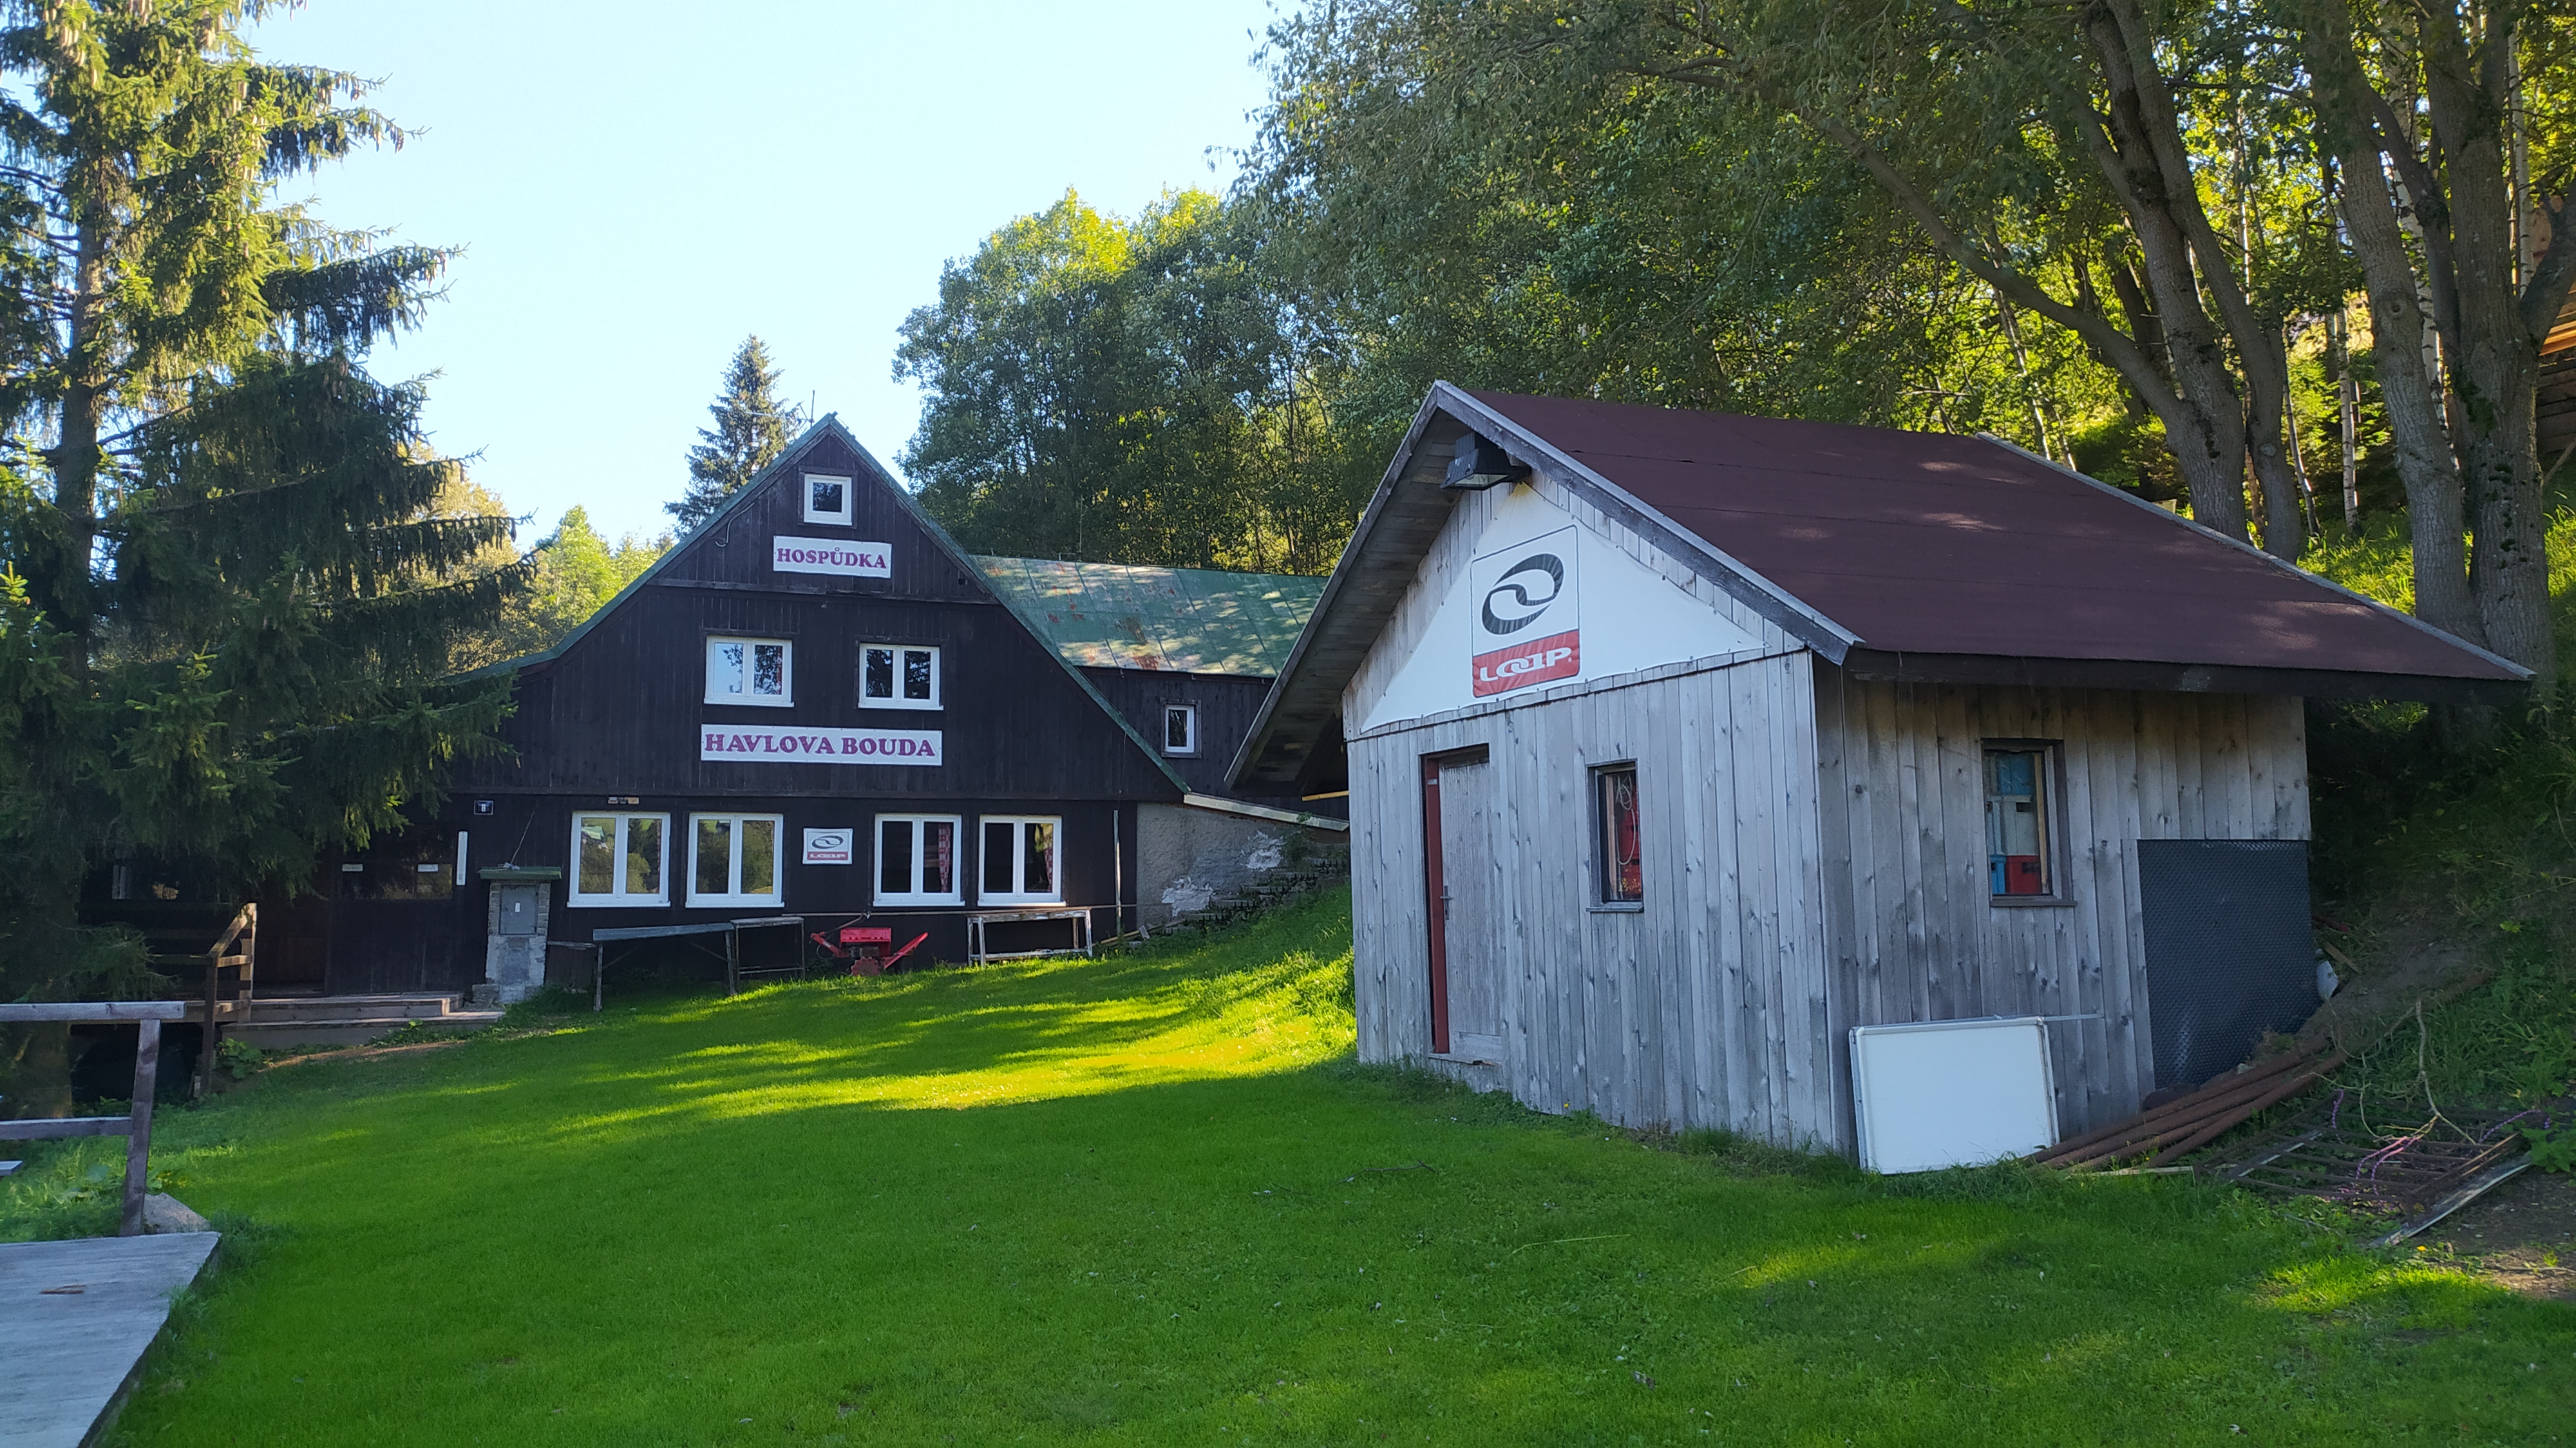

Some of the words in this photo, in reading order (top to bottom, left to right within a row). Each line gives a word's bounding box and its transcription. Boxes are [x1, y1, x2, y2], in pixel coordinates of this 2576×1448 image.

[777, 547, 887, 569] HOSPŮDKA
[705, 734, 835, 755] HAVLOVA
[841, 737, 936, 757] BOUDA
